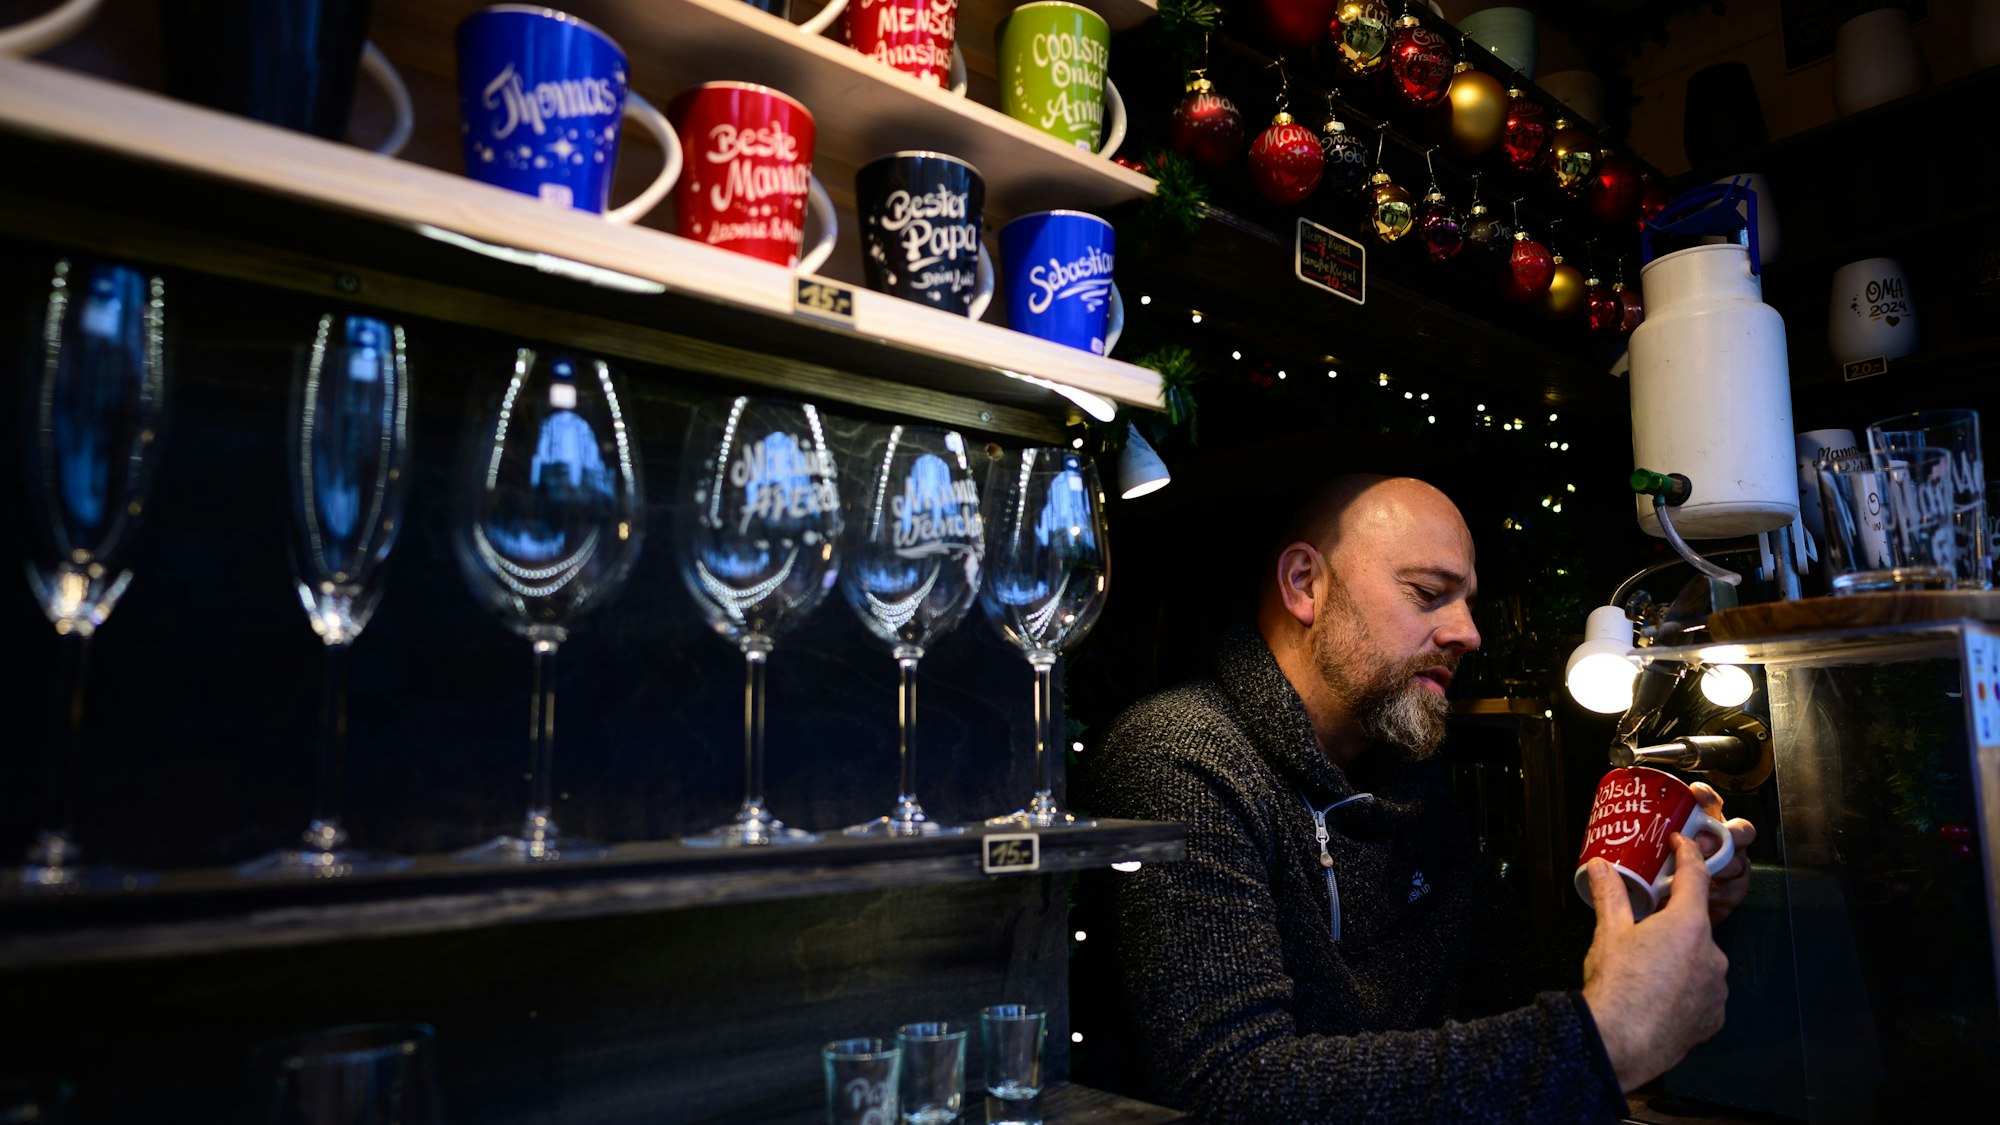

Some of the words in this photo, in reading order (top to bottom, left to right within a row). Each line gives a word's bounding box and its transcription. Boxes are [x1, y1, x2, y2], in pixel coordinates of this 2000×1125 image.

[1051, 61, 1103, 91] Onkel
[482, 62, 617, 140] Thomas
[705, 120, 799, 164] Beste
[881, 183, 968, 231] Bester
[900, 219, 977, 261] Papa
[1866, 278, 1904, 304] OMA
[1868, 300, 1908, 318] 2024
